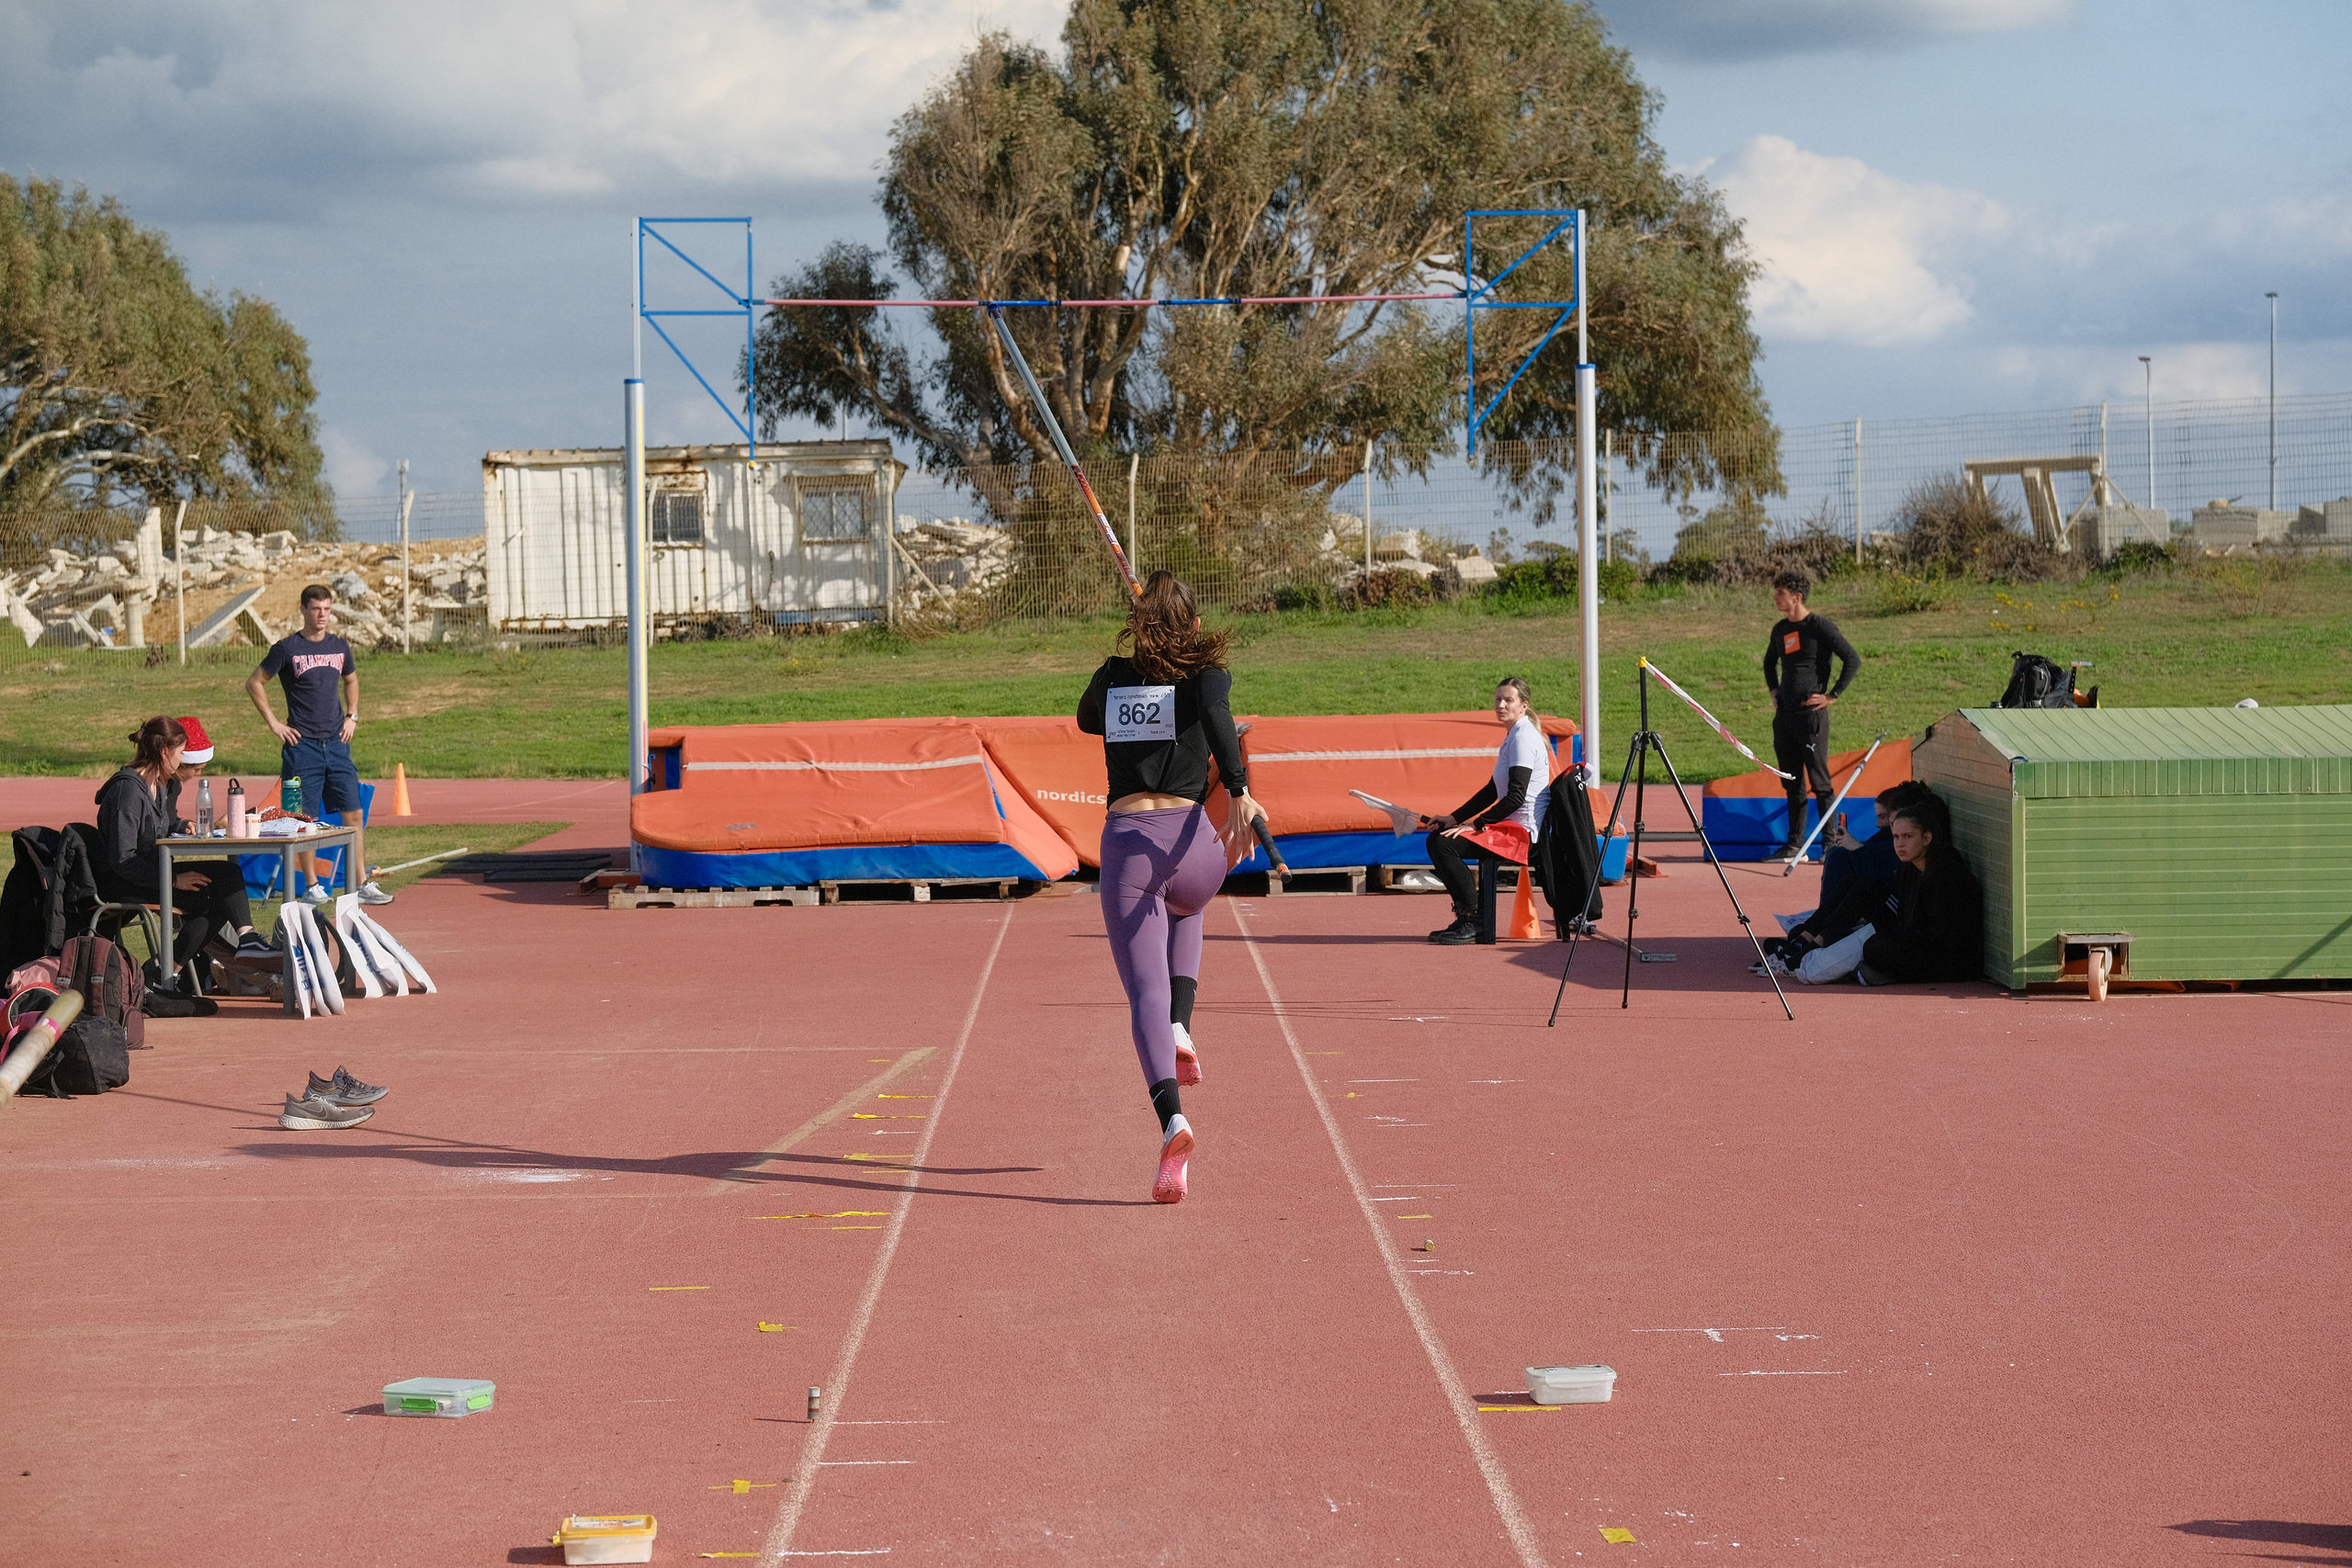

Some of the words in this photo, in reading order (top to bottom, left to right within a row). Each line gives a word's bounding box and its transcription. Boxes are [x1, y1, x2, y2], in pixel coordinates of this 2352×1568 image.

[292, 652, 345, 678] CHAMPION
[1118, 702, 1161, 726] 862
[1037, 789, 1107, 805] nordics
